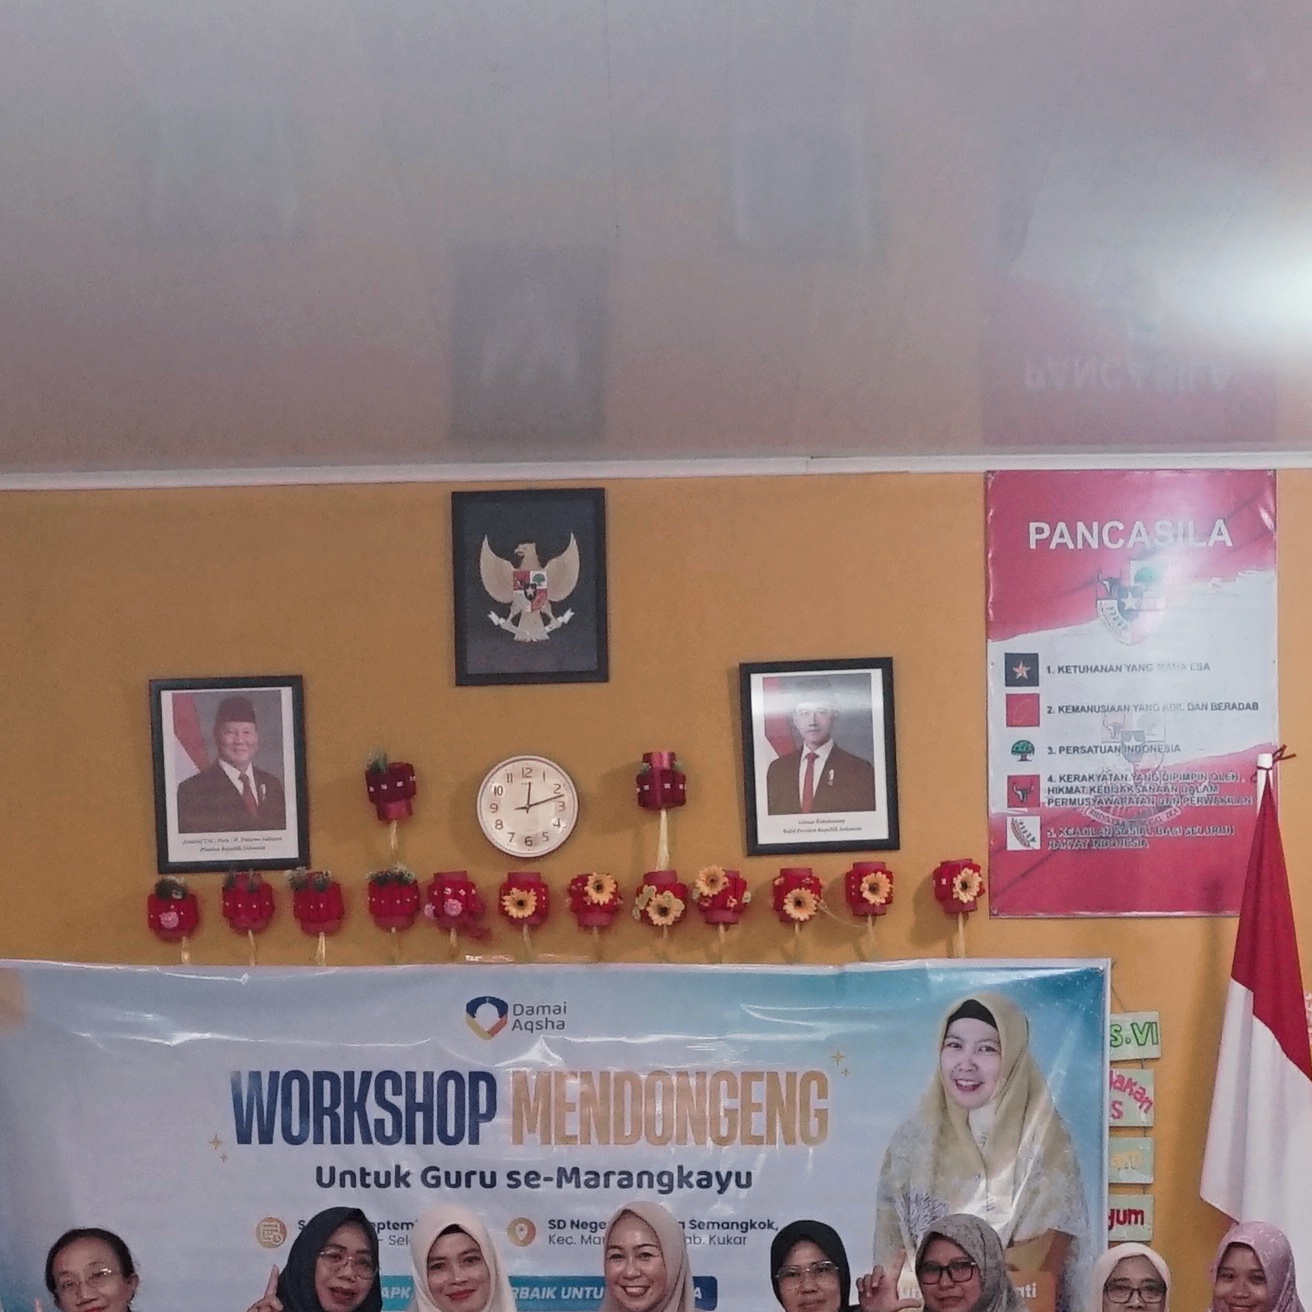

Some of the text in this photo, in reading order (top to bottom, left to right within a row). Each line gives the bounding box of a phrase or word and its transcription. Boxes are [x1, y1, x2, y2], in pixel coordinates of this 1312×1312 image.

[1029, 518, 1233, 550] PANCASILA
[1058, 663, 1122, 675] KETUHANAN
[1125, 663, 1154, 673] YANG
[1058, 704, 1130, 715] KEMANUSIAAN
[1133, 703, 1160, 713] YANG
[1188, 702, 1208, 712] DAN
[1210, 702, 1259, 711] BERADAB
[1058, 744, 1121, 755] PERSATUAN
[1123, 744, 1181, 754] INDONESIA
[507, 773, 513, 783] 11
[522, 767, 532, 778] 12
[1059, 773, 1128, 783] KERAKYATAN
[1131, 773, 1159, 783] YANG
[494, 785, 503, 796] 10
[554, 783, 561, 794] 2
[1047, 785, 1086, 795] HIKMAT
[490, 803, 498, 813] 9
[559, 801, 565, 812] 3
[495, 819, 503, 830] 8
[553, 818, 561, 828] 4
[508, 832, 515, 842] 7
[525, 836, 533, 847] 6
[542, 832, 549, 842] 5
[513, 1002, 568, 1017] Damai
[511, 1018, 566, 1033] Aqsha
[230, 1069, 829, 1146] WORKSHOP MENDONGENG
[316, 1165, 753, 1195] Untuk Guru se-Marangkayu
[548, 1219, 607, 1233] SD Nege
[689, 1219, 778, 1234] Semangkok,
[548, 1234, 577, 1246] Kec.
[684, 1234, 747, 1246] ab. Kukar
[512, 1286, 605, 1299] RBAIK UNTU
